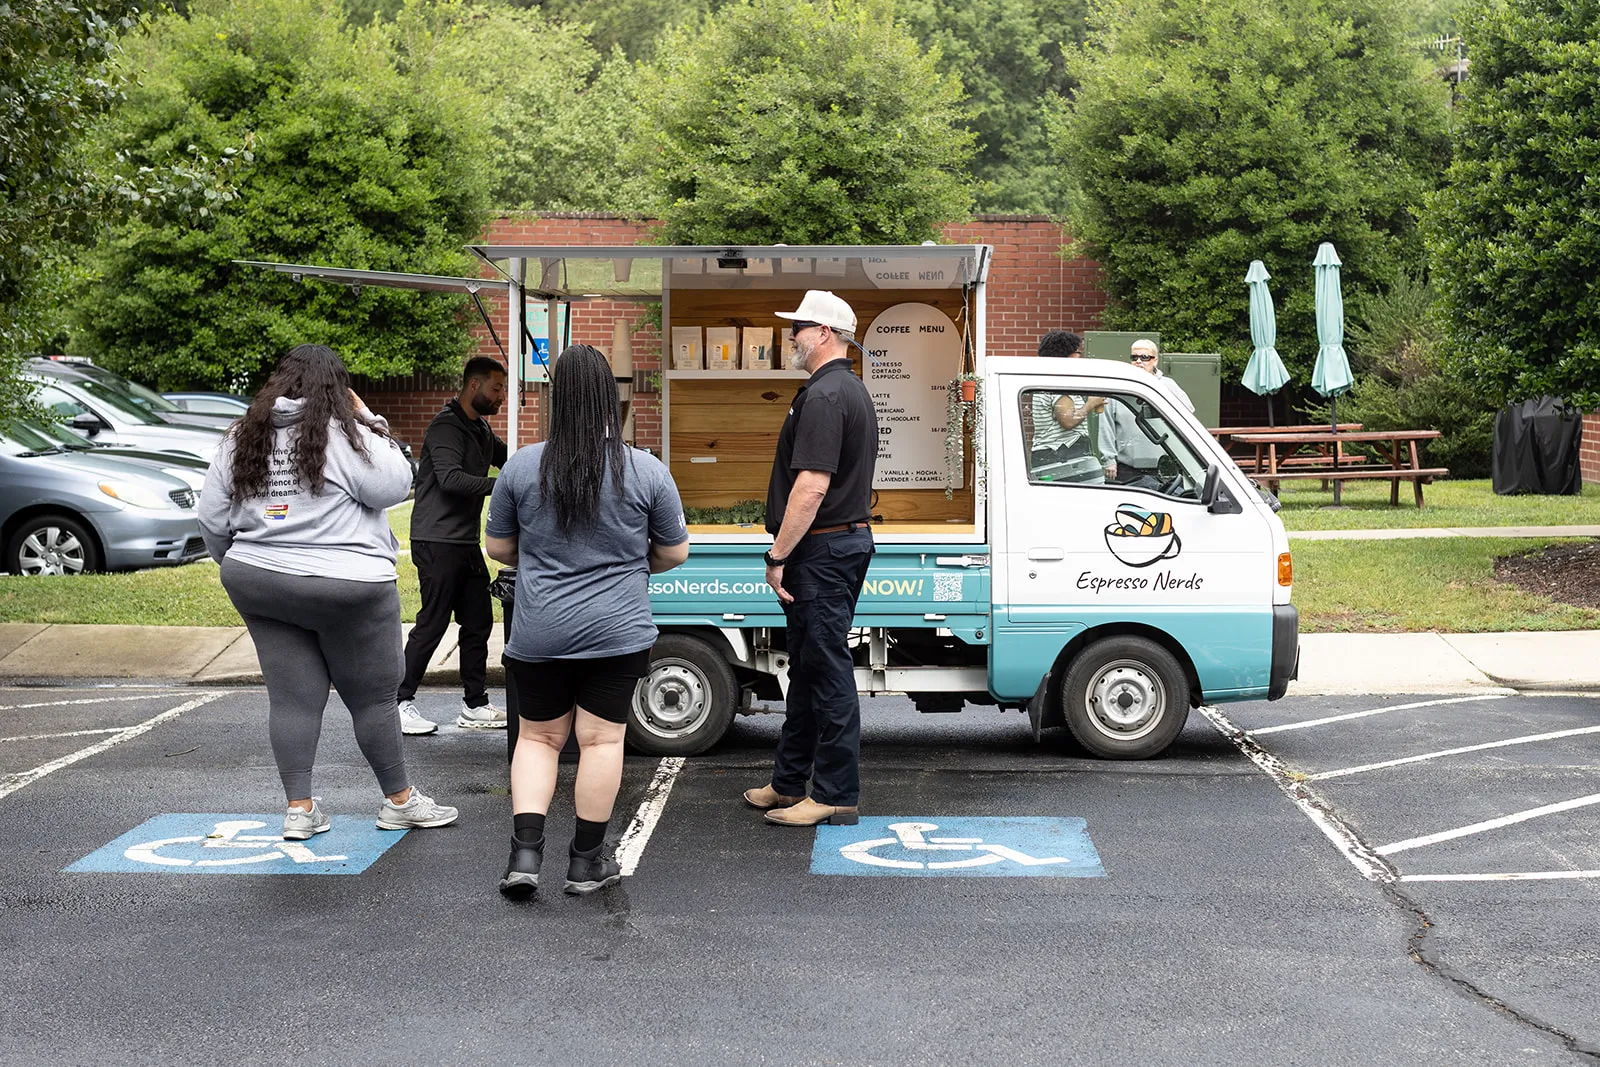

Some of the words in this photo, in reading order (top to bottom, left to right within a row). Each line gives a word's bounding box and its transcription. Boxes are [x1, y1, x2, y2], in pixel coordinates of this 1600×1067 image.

[876, 326, 911, 334] COFFEE
[919, 325, 945, 333] MENU
[868, 349, 888, 357] HOT
[271, 489, 300, 497] dreams.
[1076, 571, 1148, 594] Espresso
[1153, 569, 1204, 592] Nerds
[647, 579, 773, 594] ssoNerds.com
[863, 579, 924, 596] NOW!
